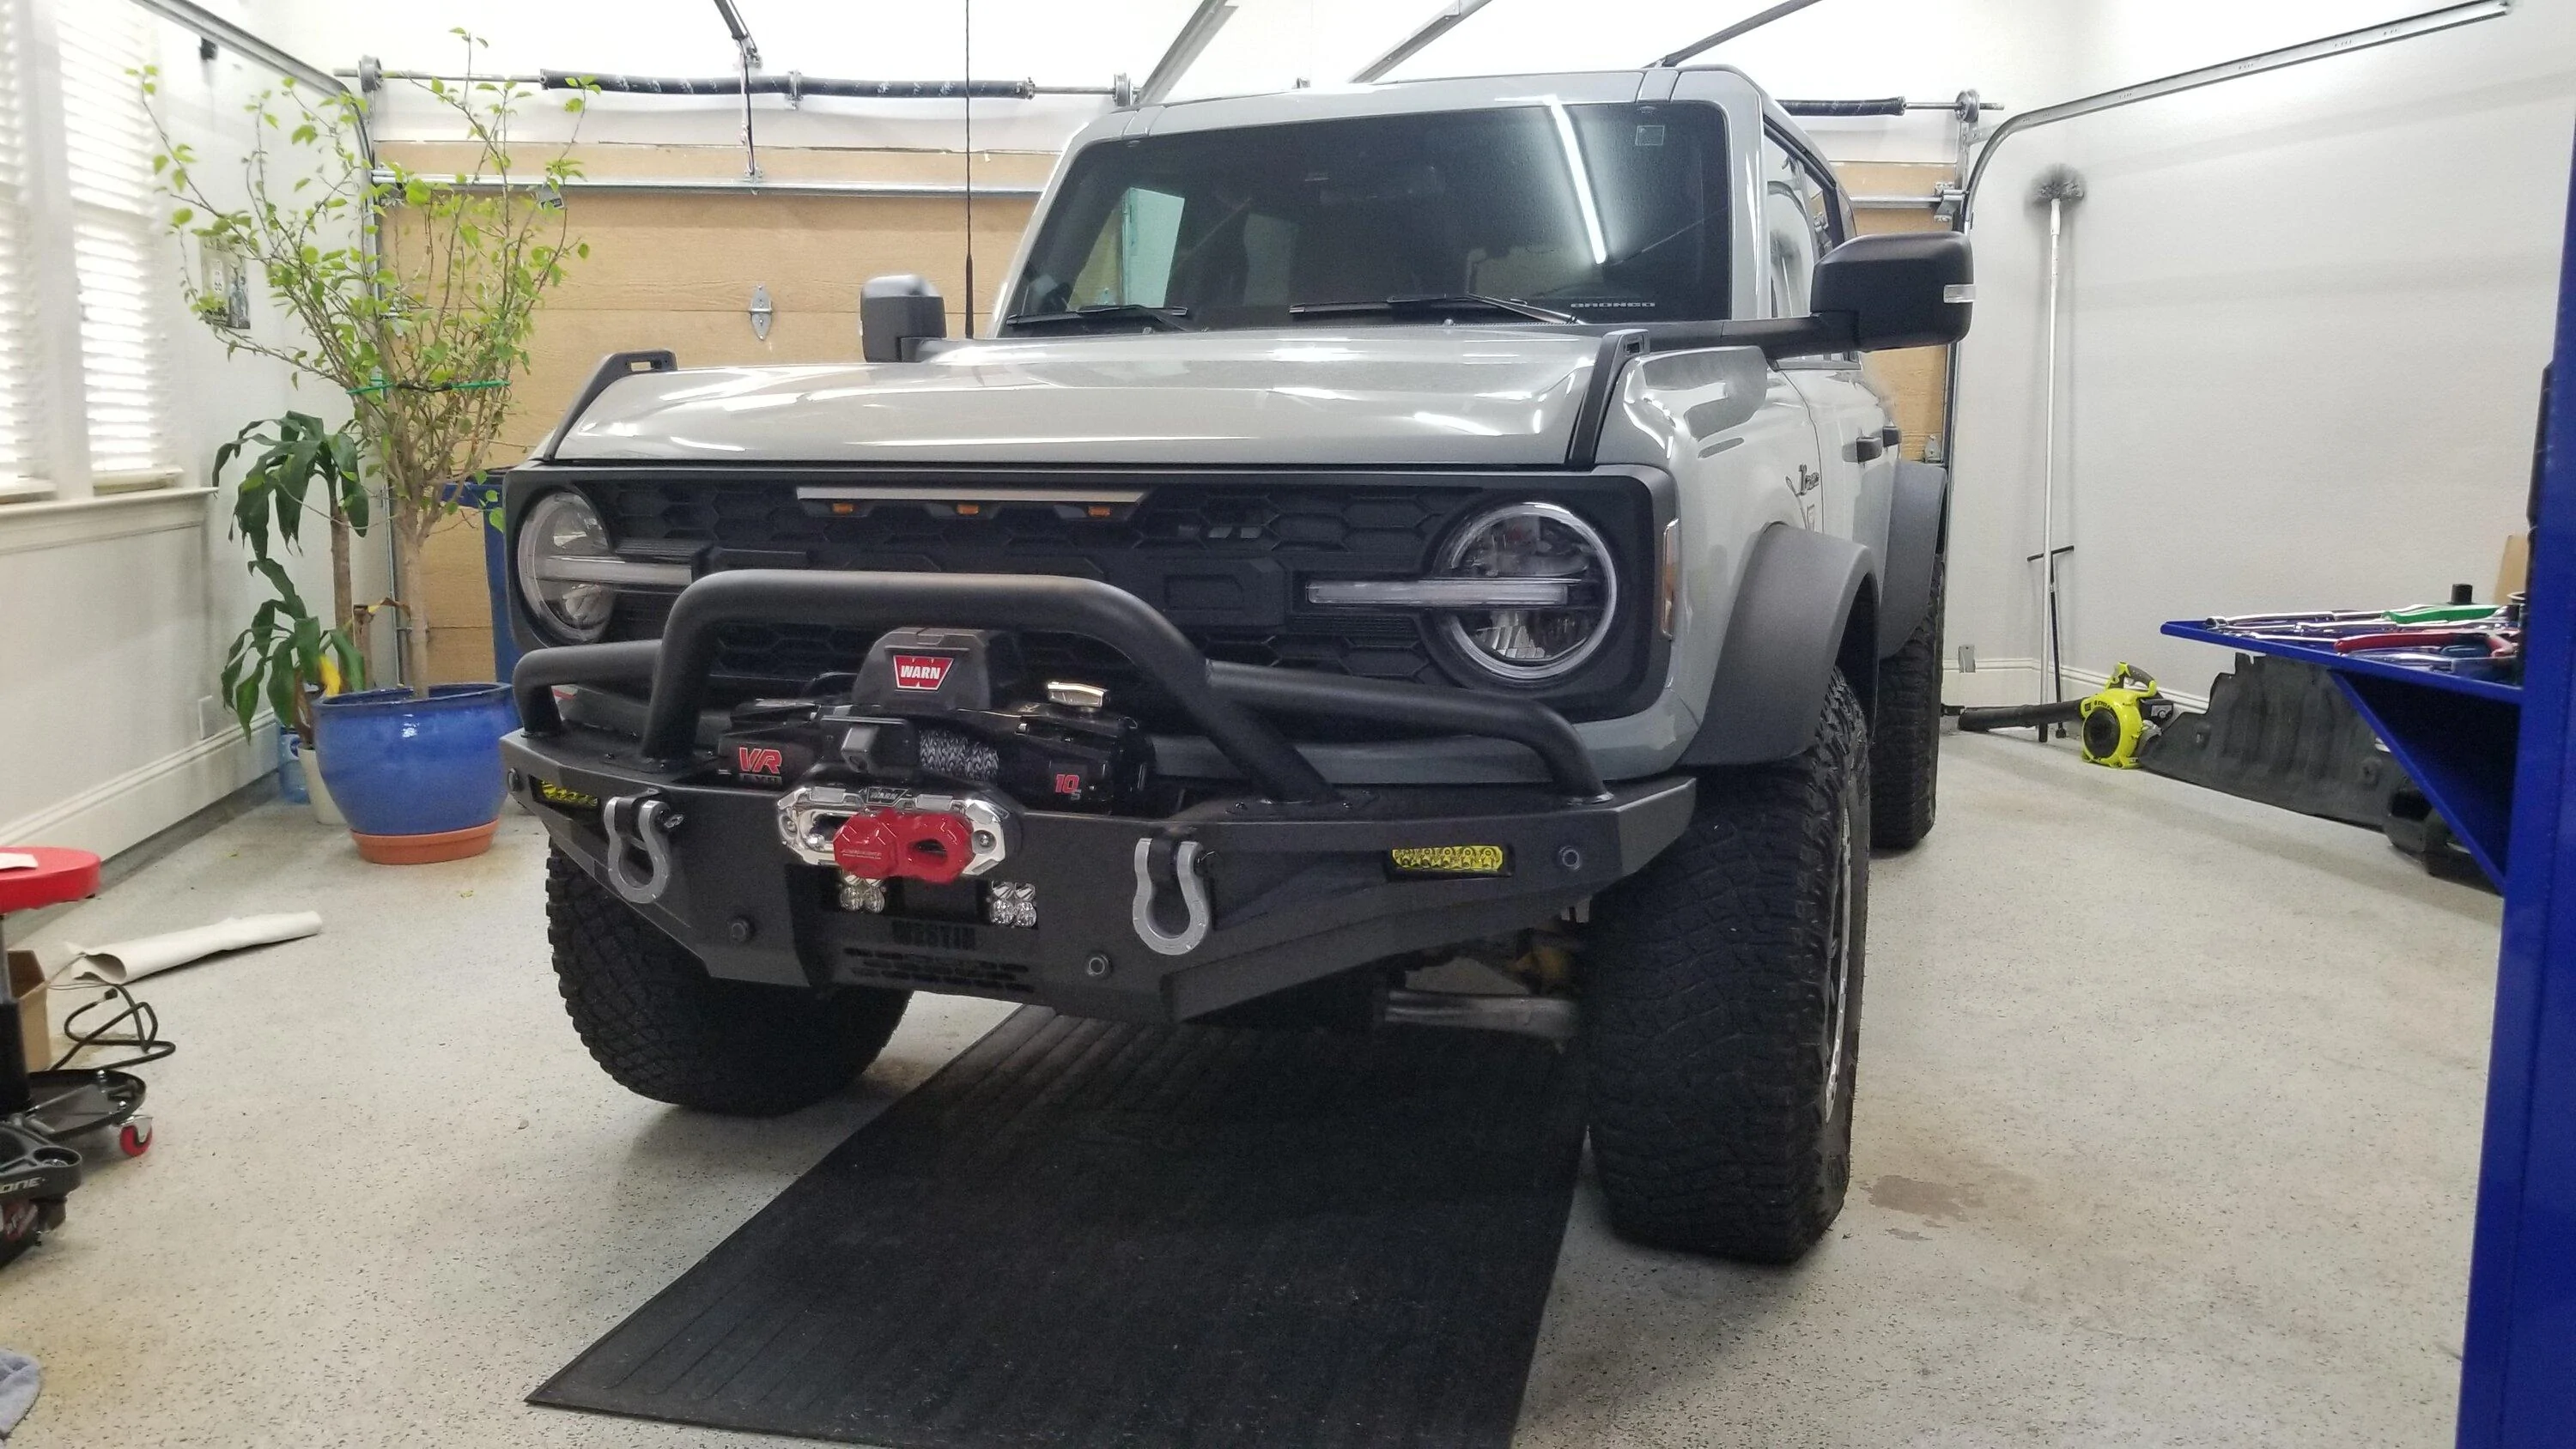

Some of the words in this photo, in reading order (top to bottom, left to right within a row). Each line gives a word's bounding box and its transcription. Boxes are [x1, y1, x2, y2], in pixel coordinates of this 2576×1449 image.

[900, 664, 941, 680] WARN
[738, 747, 782, 774] VR
[1054, 774, 1079, 793] 10
[870, 791, 898, 801] WARN
[0, 1176, 42, 1194] ONE
